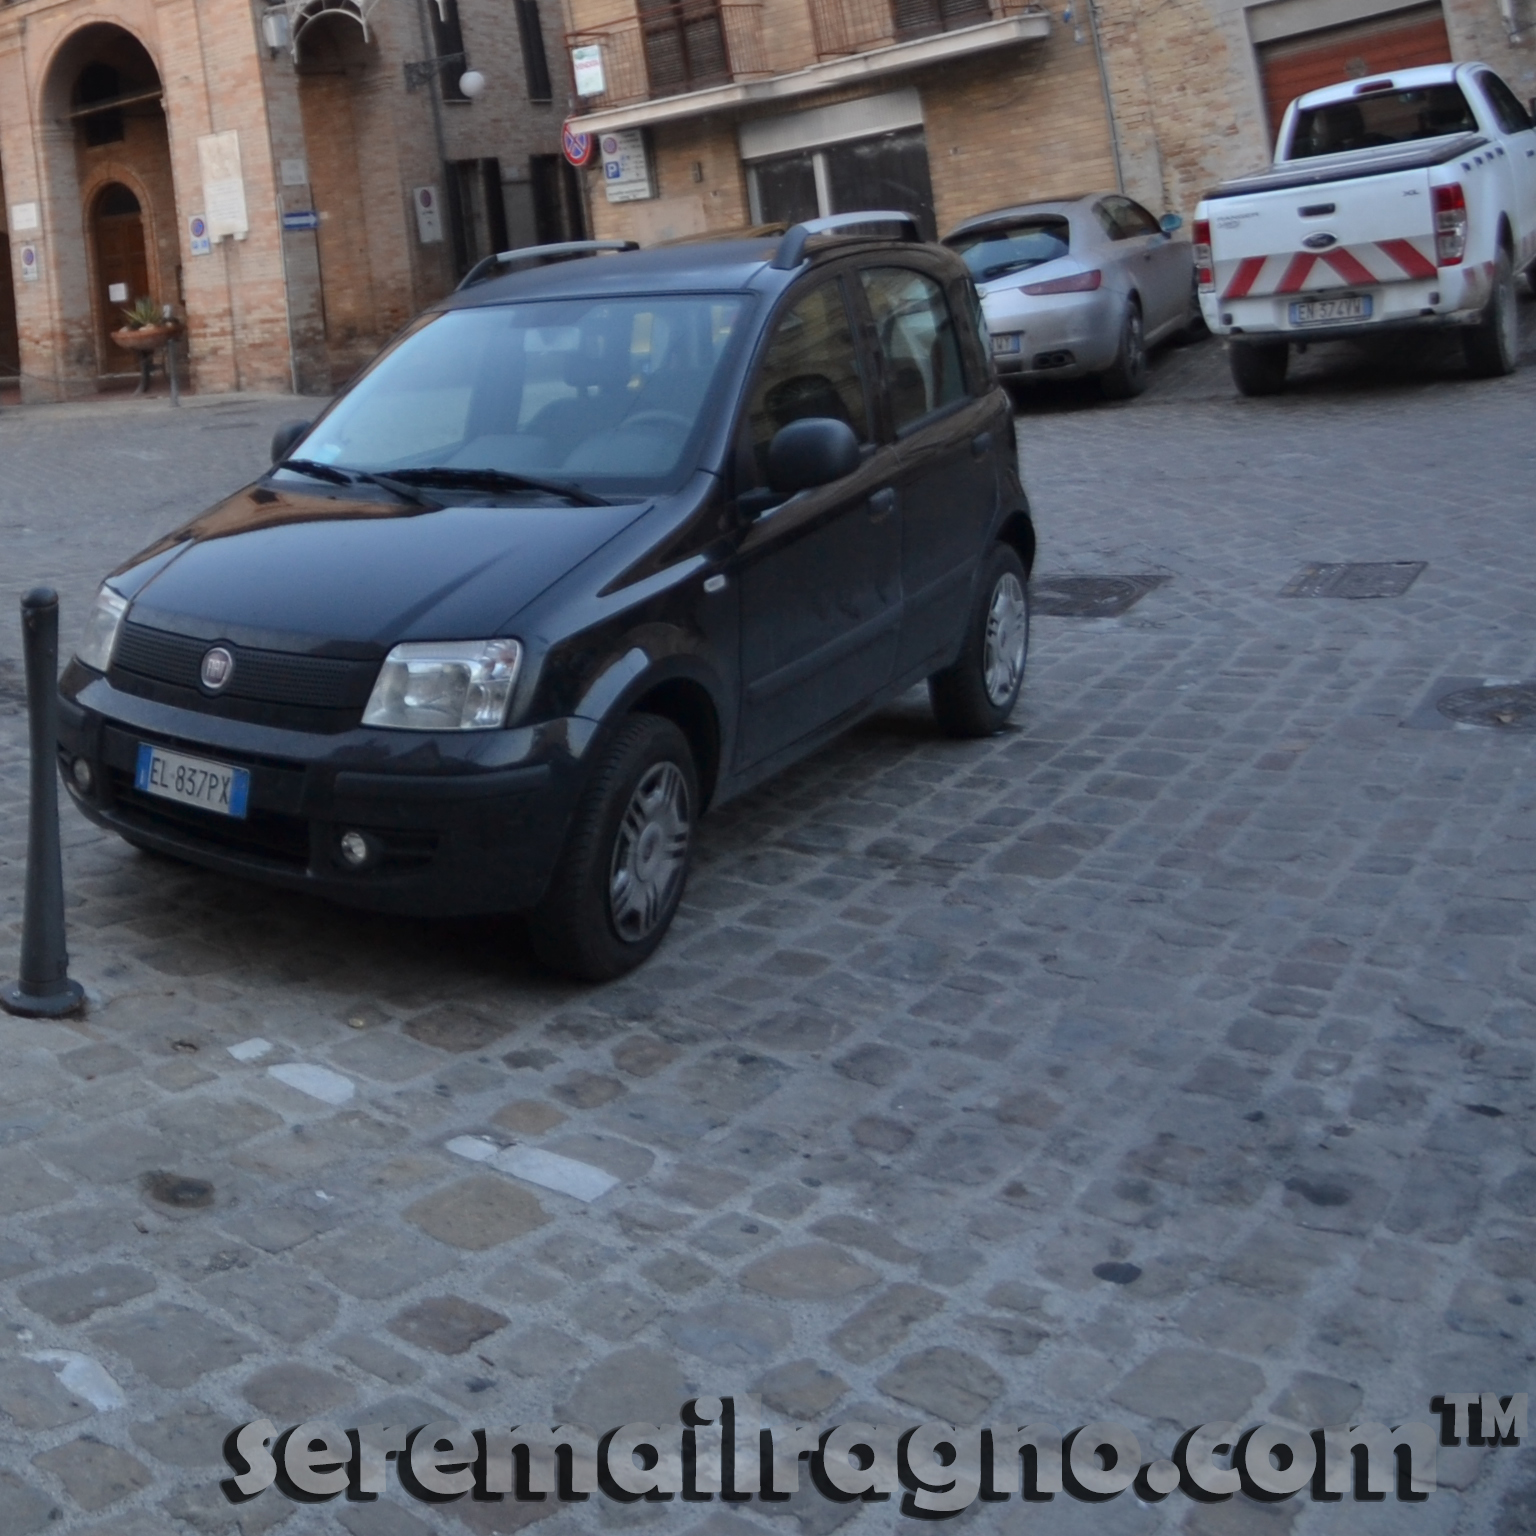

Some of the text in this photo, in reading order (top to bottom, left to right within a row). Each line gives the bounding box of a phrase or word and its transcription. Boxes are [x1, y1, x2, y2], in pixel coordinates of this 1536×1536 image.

[1298, 302, 1317, 322] EN
[206, 658, 227, 679] FIAT
[150, 757, 232, 806] EL 837PX
